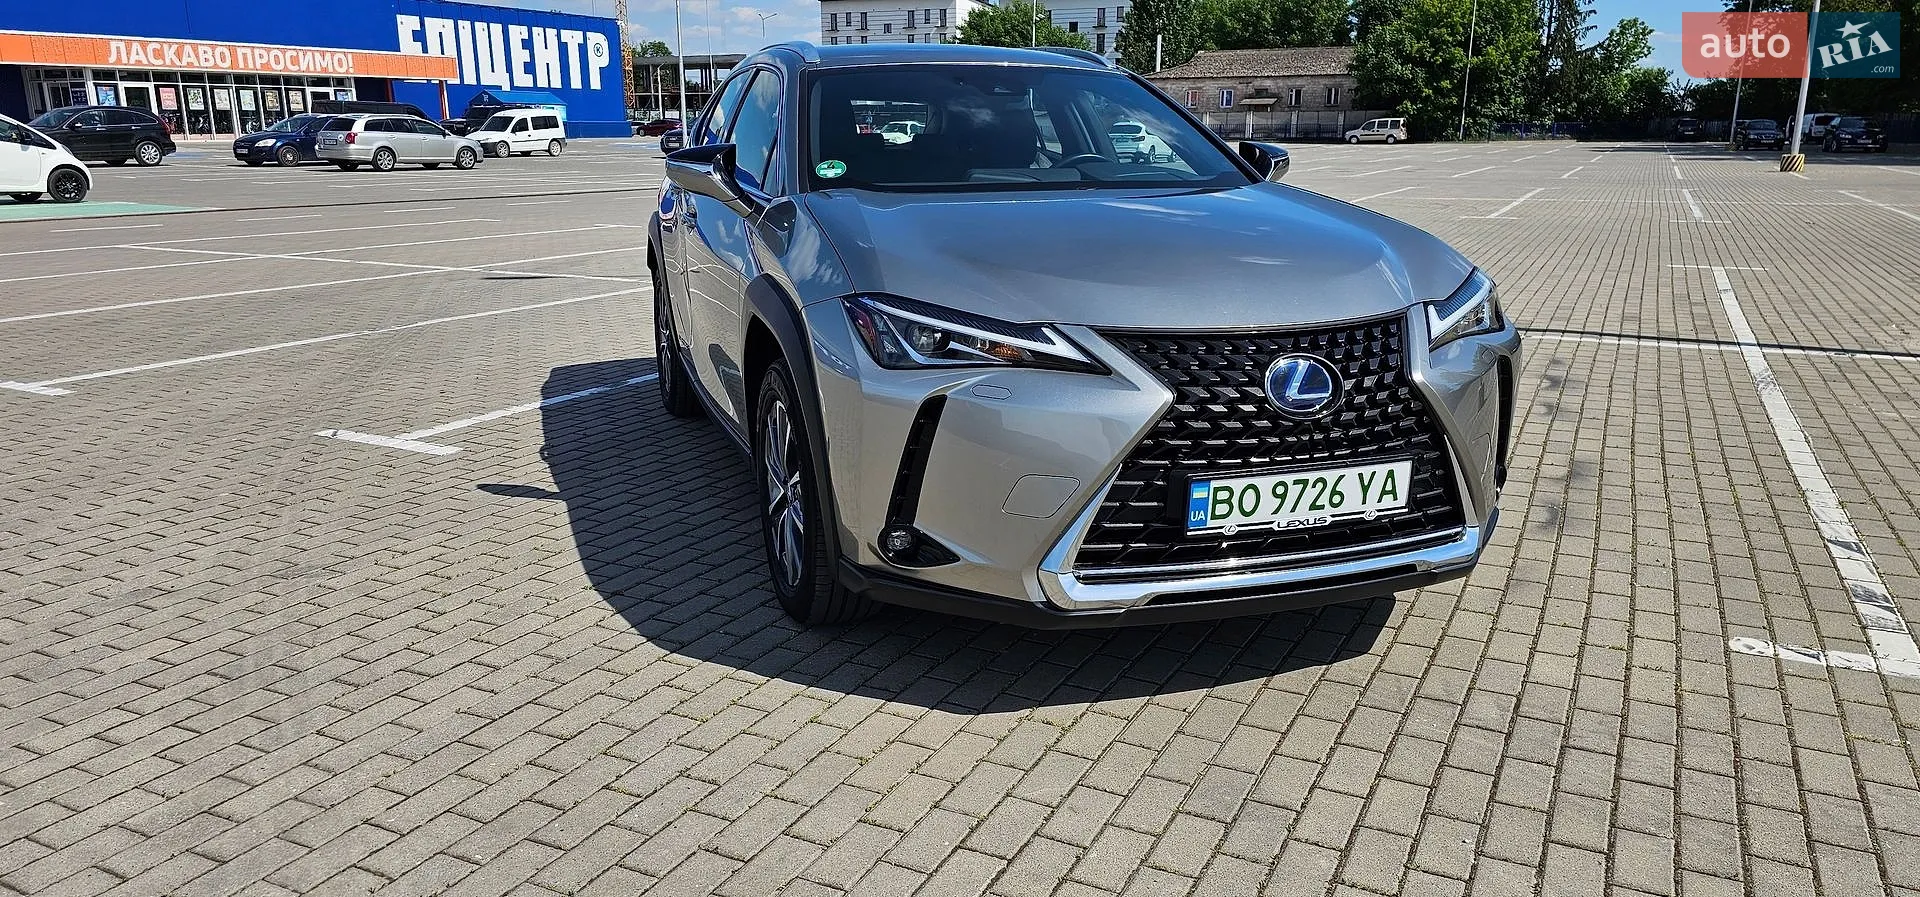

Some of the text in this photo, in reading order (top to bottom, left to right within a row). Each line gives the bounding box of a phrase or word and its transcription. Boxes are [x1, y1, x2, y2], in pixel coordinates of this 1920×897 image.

[108, 41, 354, 74] ЛАСКАВО ПРОСИМО!
[396, 14, 610, 91] ЕПІЦЕНТР
[1210, 468, 1399, 521] BO 9726 YA
[1190, 510, 1206, 522] UA
[1277, 516, 1328, 529] LEXUS
